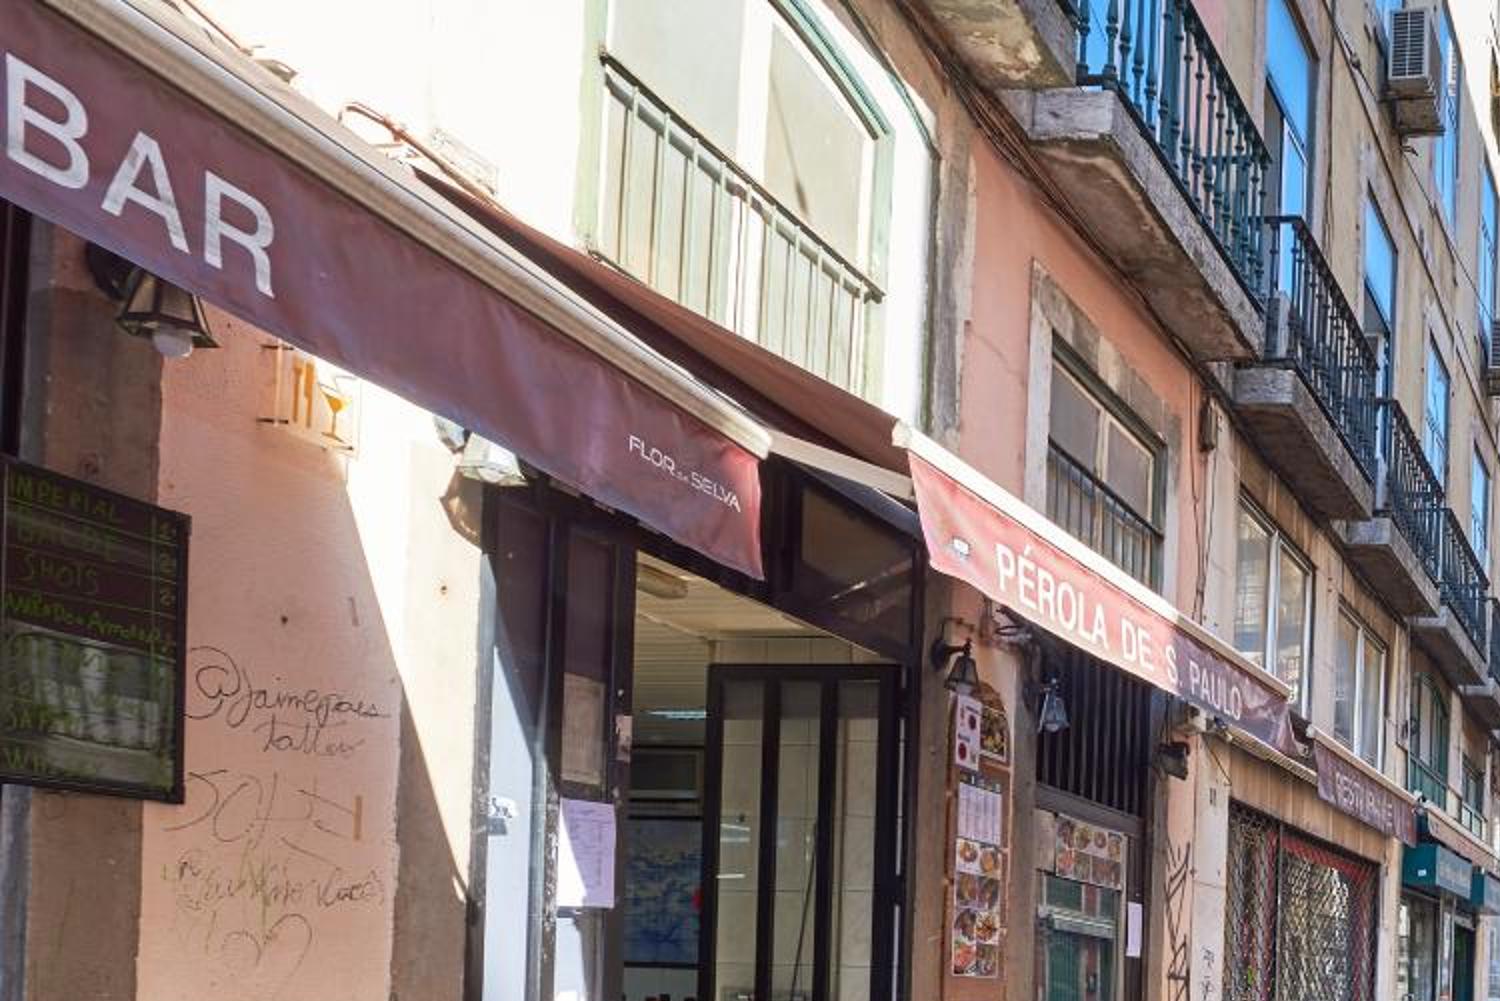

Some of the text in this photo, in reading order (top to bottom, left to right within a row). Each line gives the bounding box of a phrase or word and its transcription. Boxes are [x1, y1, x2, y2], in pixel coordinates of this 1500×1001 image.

[5, 51, 275, 299] BAR
[628, 434, 676, 477] FLOR
[690, 471, 741, 513] SELVA
[995, 543, 1110, 650] PÉROLA
[1121, 617, 1156, 674] DE
[1189, 660, 1242, 721] PAULO
